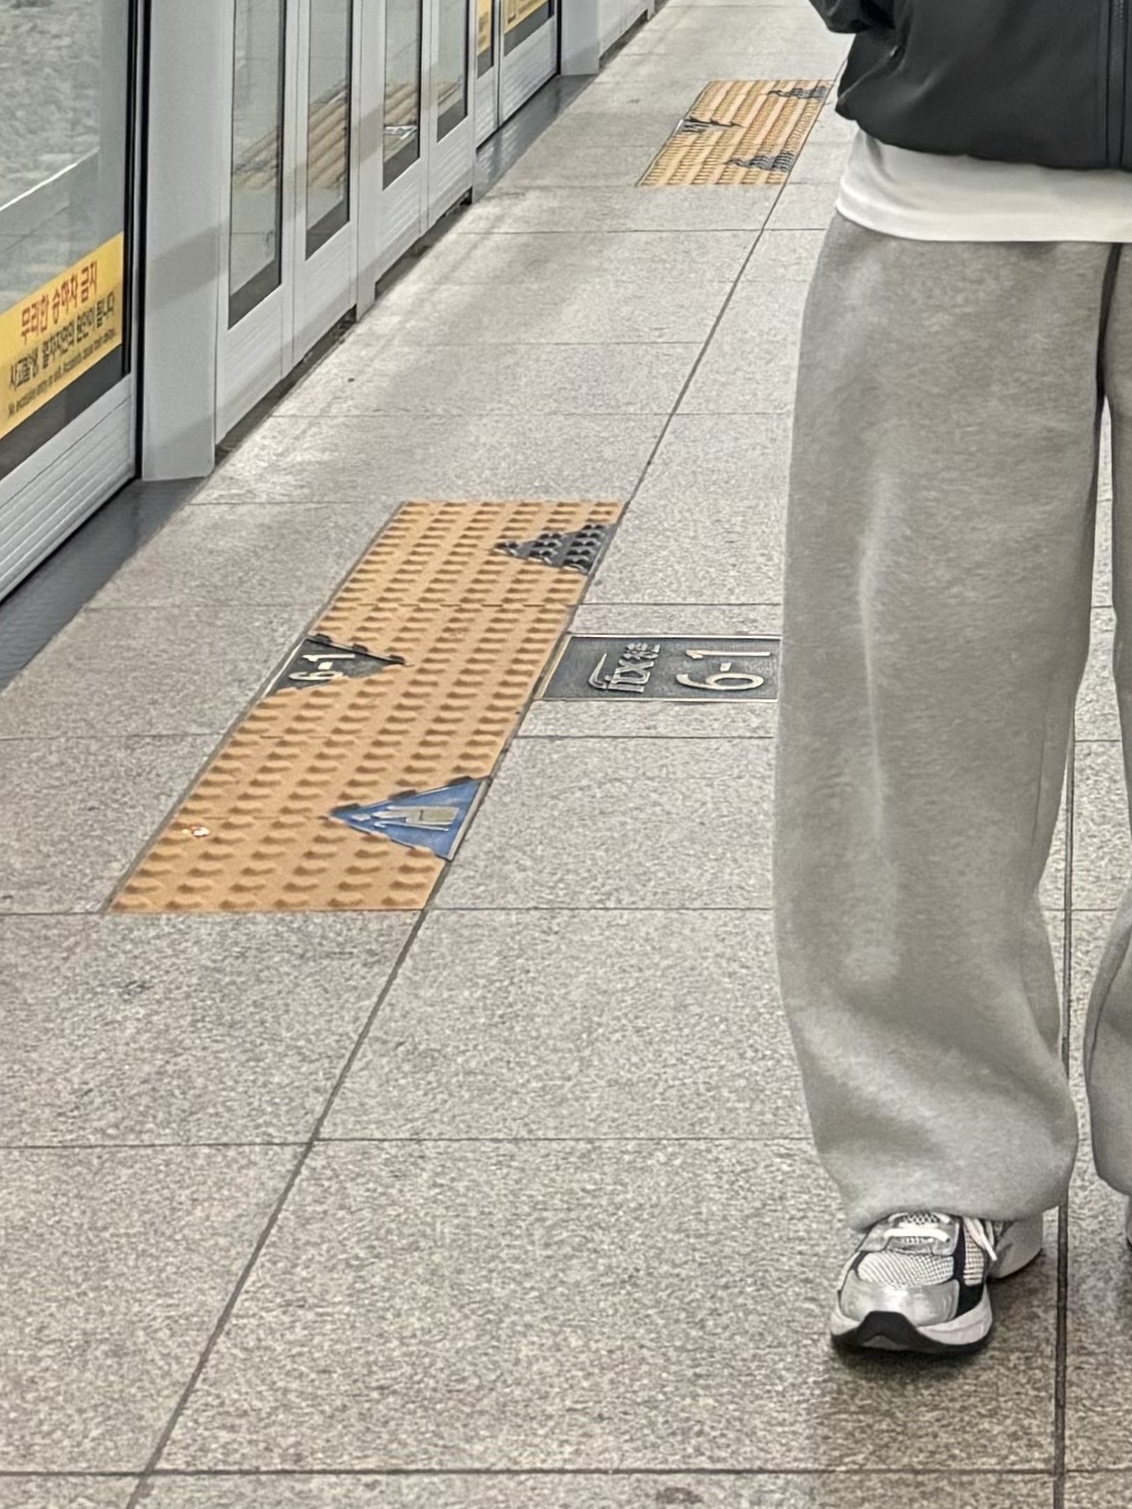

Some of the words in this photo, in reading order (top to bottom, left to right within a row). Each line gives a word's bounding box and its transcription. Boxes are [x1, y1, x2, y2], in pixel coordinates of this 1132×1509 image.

[20, 293, 50, 344] 무리한
[51, 272, 79, 325] 승하차
[80, 260, 98, 304] 금지
[288, 653, 356, 681] 6-1
[675, 649, 771, 690] 6-1
